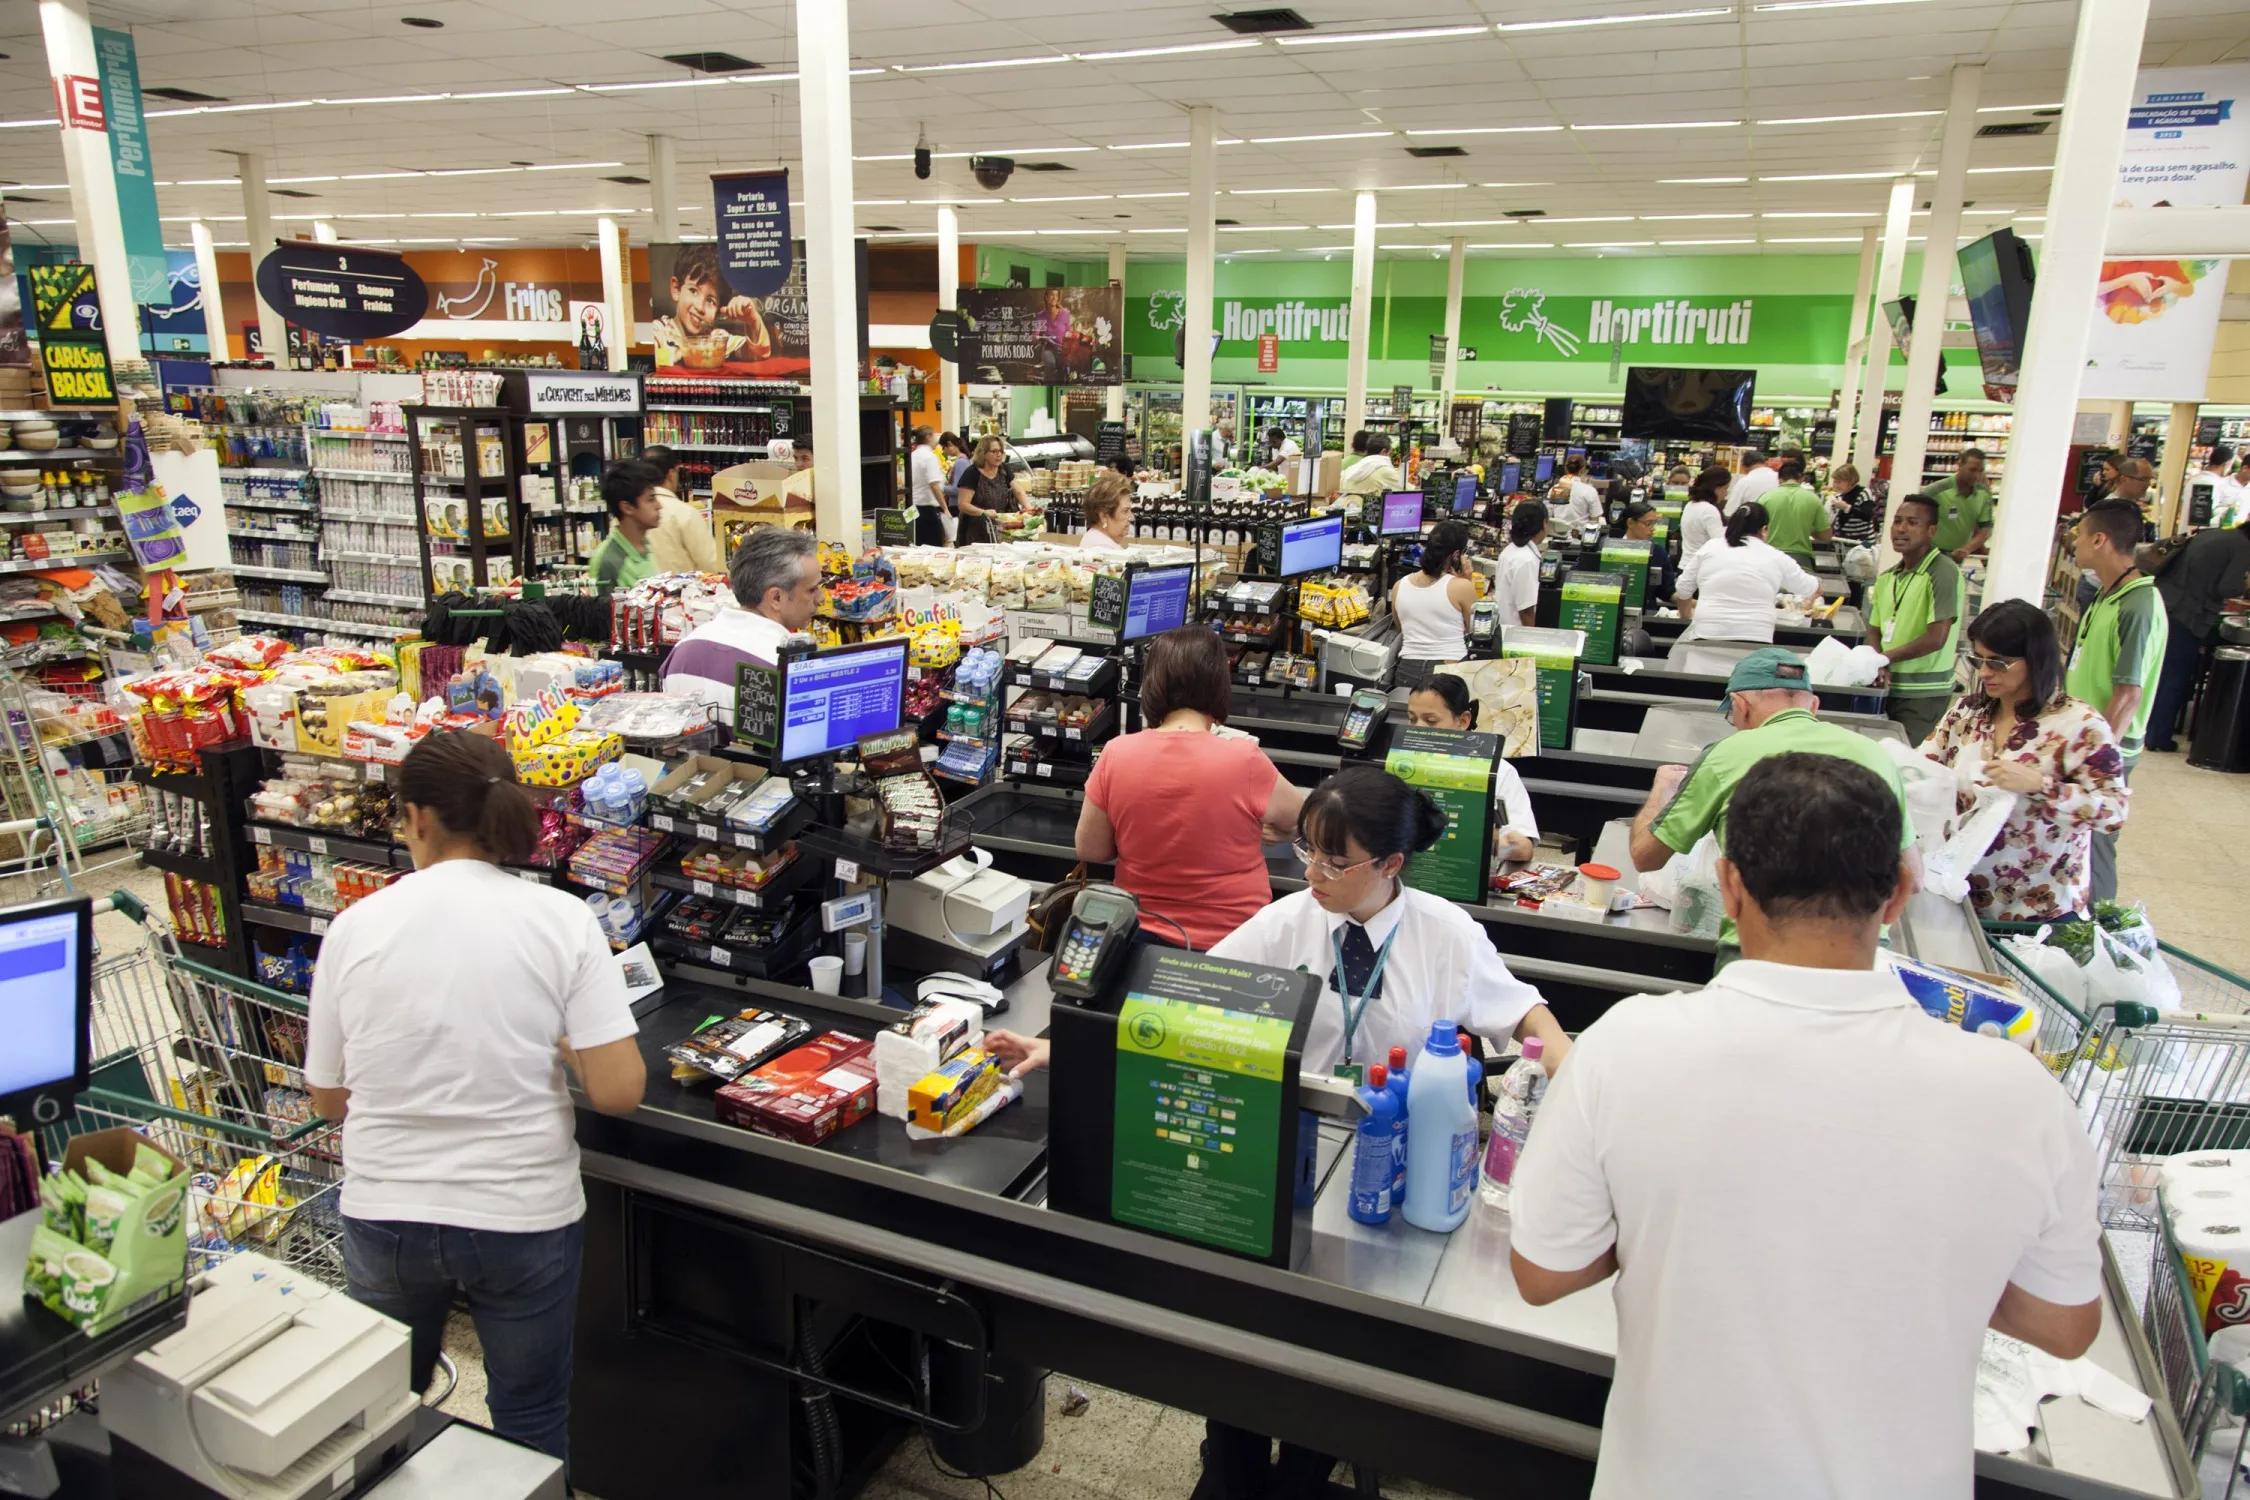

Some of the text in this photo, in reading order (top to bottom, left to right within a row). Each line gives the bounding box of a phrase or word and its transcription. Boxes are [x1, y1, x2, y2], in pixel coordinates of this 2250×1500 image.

[72, 80, 103, 118] E
[102, 40, 145, 177] Perfumaria
[2130, 164, 2142, 173] de
[2144, 165, 2165, 173] casa
[2167, 163, 2188, 172] sem
[2189, 161, 2238, 173] agasalho.
[2122, 173, 2197, 184] Leve para doar.
[737, 192, 764, 202] Portaria
[727, 204, 745, 214] Super
[732, 221, 740, 230] No
[747, 231, 768, 240] produto
[338, 256, 347, 271] 3
[291, 279, 340, 294] Perfumaria
[357, 284, 394, 298] Shampoo
[295, 294, 347, 309] Higiene Oral
[362, 300, 393, 312] Fraldas
[504, 282, 563, 321] Frios
[765, 296, 809, 314] ORGAN
[1223, 301, 1350, 342] Hortifrut
[1588, 300, 1752, 344] Hortifruti
[1012, 345, 1035, 360] RODAS
[51, 371, 112, 398] BRASIL
[172, 505, 198, 517] taeq
[904, 602, 956, 628] Confeti
[794, 661, 815, 672] SIAC
[744, 668, 772, 687] FAÇA
[516, 680, 567, 737] Confeti
[739, 704, 776, 726] CELULAR
[742, 720, 765, 736] AQUI
[516, 758, 545, 774] Confeti
[725, 934, 748, 942] HALLS
[1199, 962, 1228, 976] Cliente
[1228, 967, 1253, 980] Mais?
[32, 1094, 61, 1123] 6
[2194, 1260, 2216, 1276] 12
